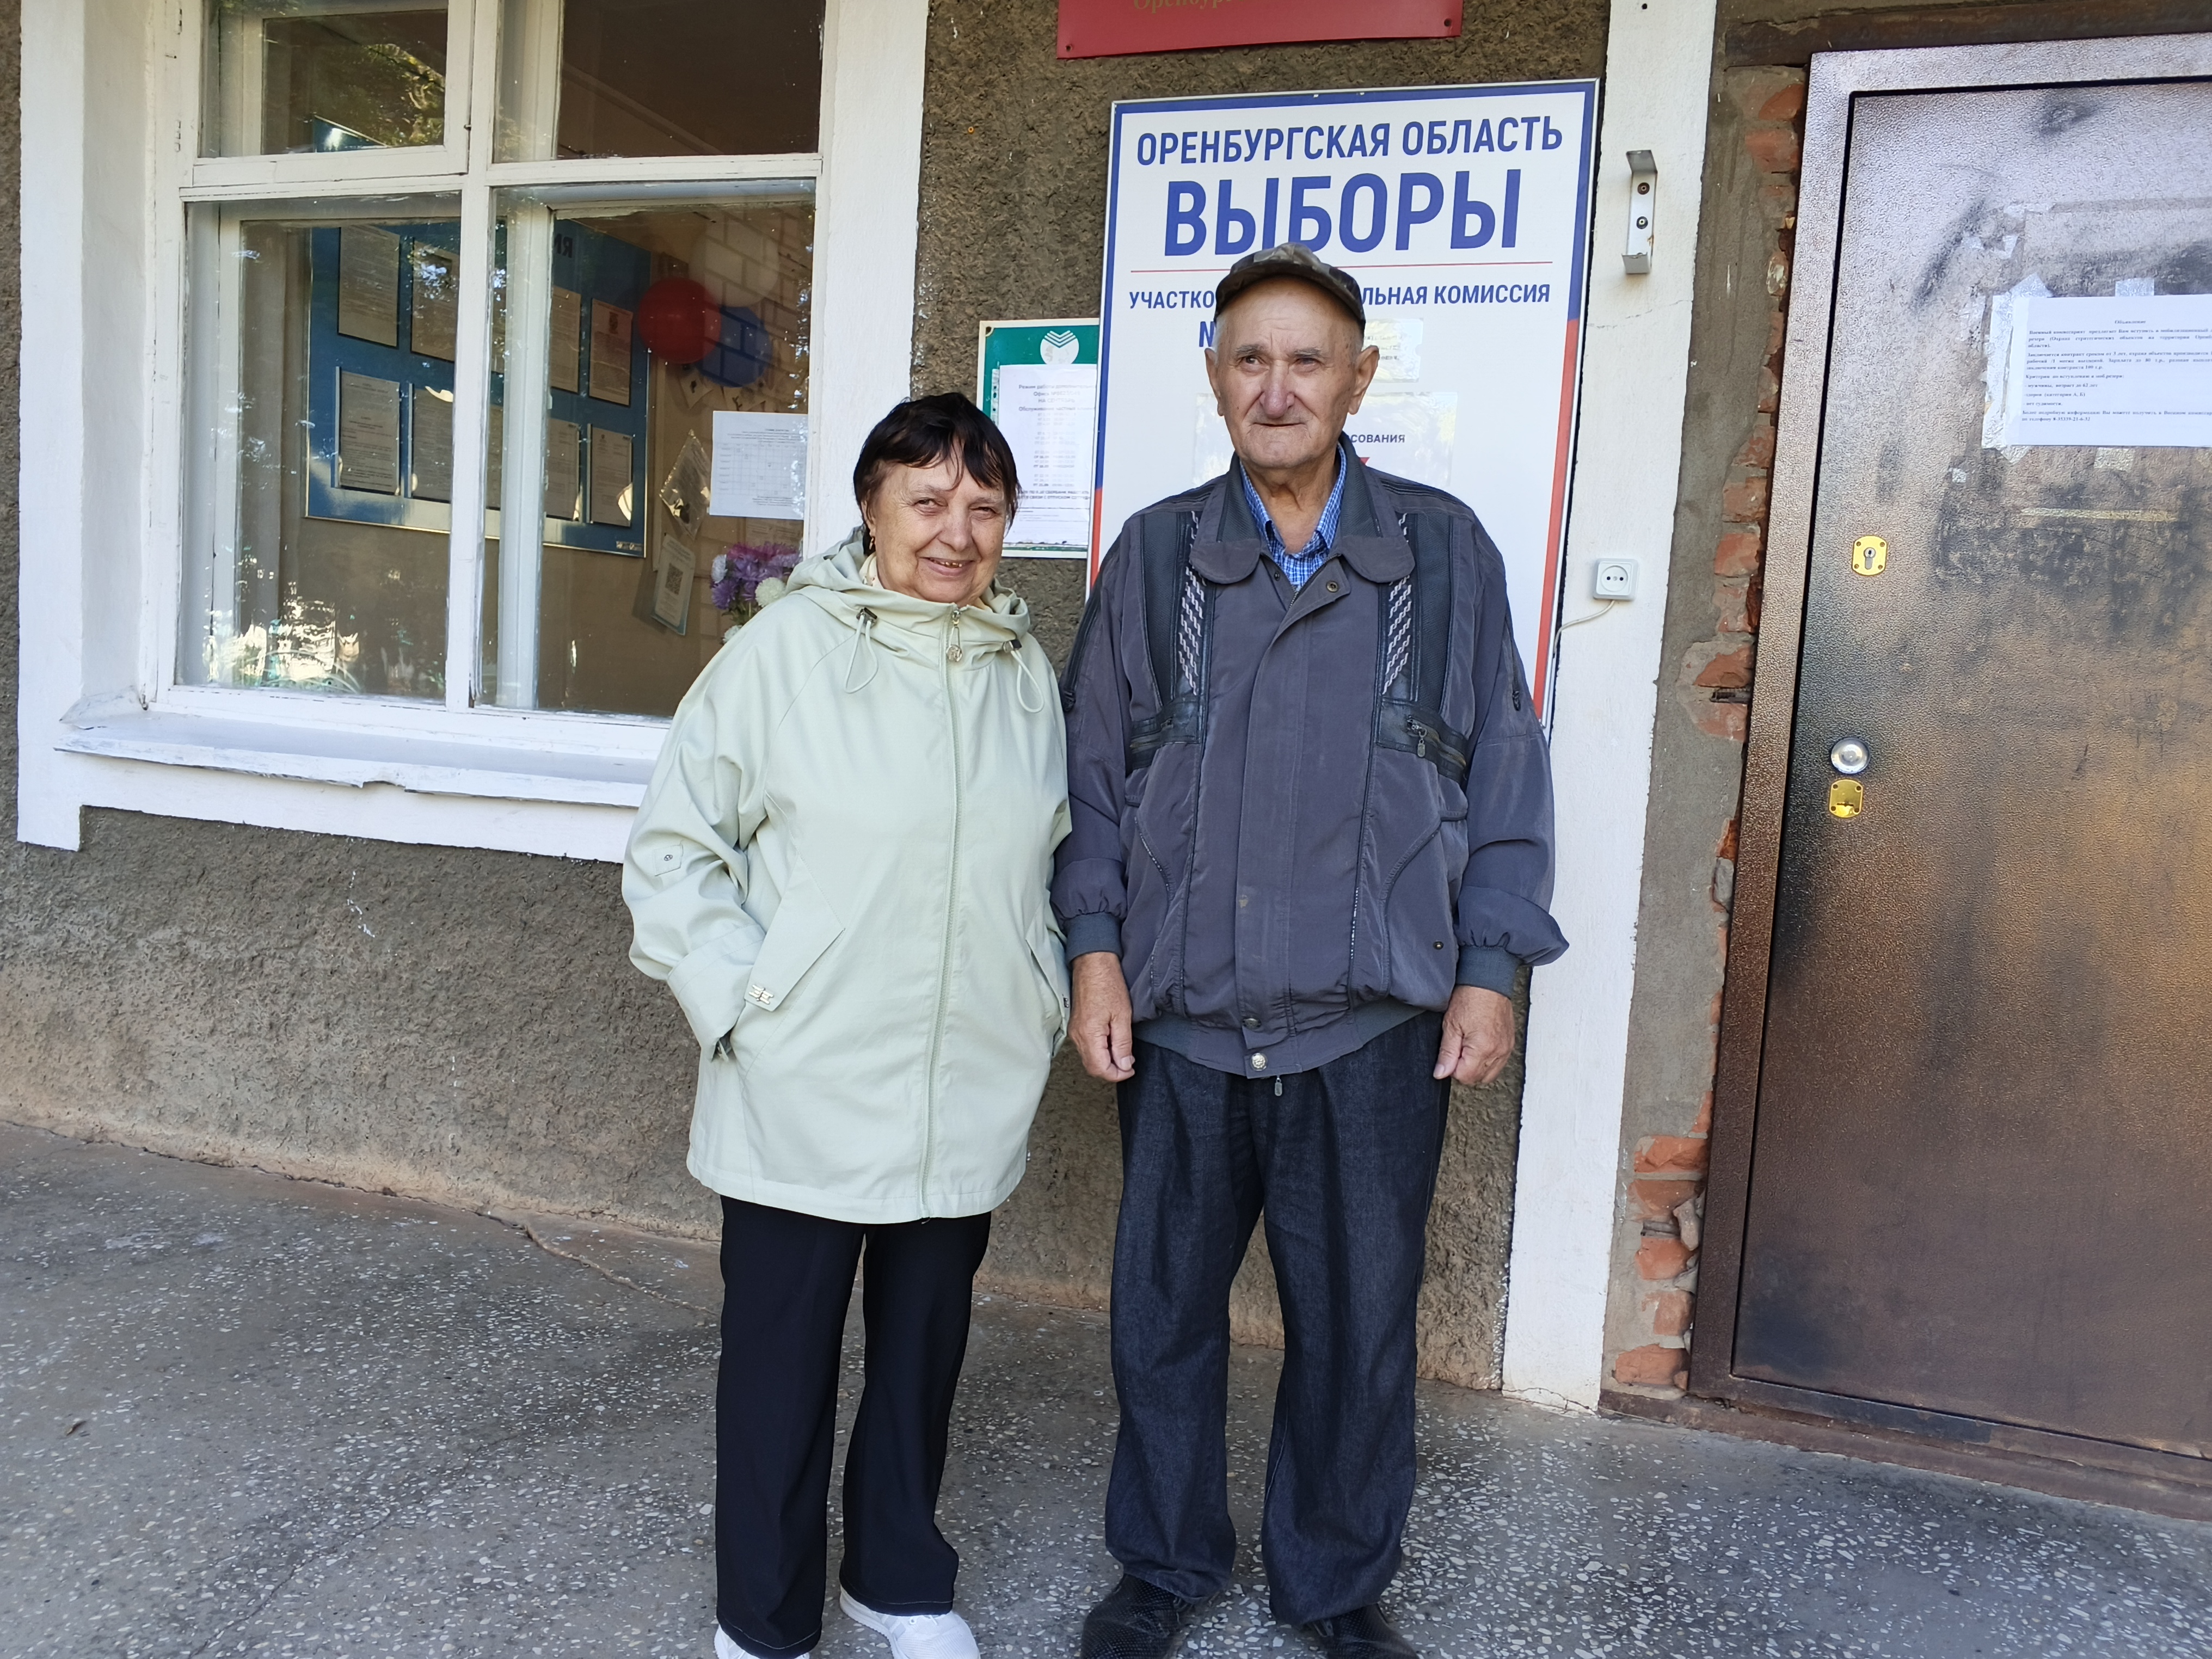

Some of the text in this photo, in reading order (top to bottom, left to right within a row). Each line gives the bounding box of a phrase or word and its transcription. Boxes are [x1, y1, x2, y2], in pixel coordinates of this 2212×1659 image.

[1137, 116, 1563, 165] ОРЕНБУРГСКАЯ ОБЛАСТЬ
[1165, 169, 1521, 256] ВЫБОРЫ
[1129, 284, 1550, 309] УЧАСТКО ЛЬНАЯ КОМИССИЯ
[1351, 434, 1405, 443] СОВАНИЯ
